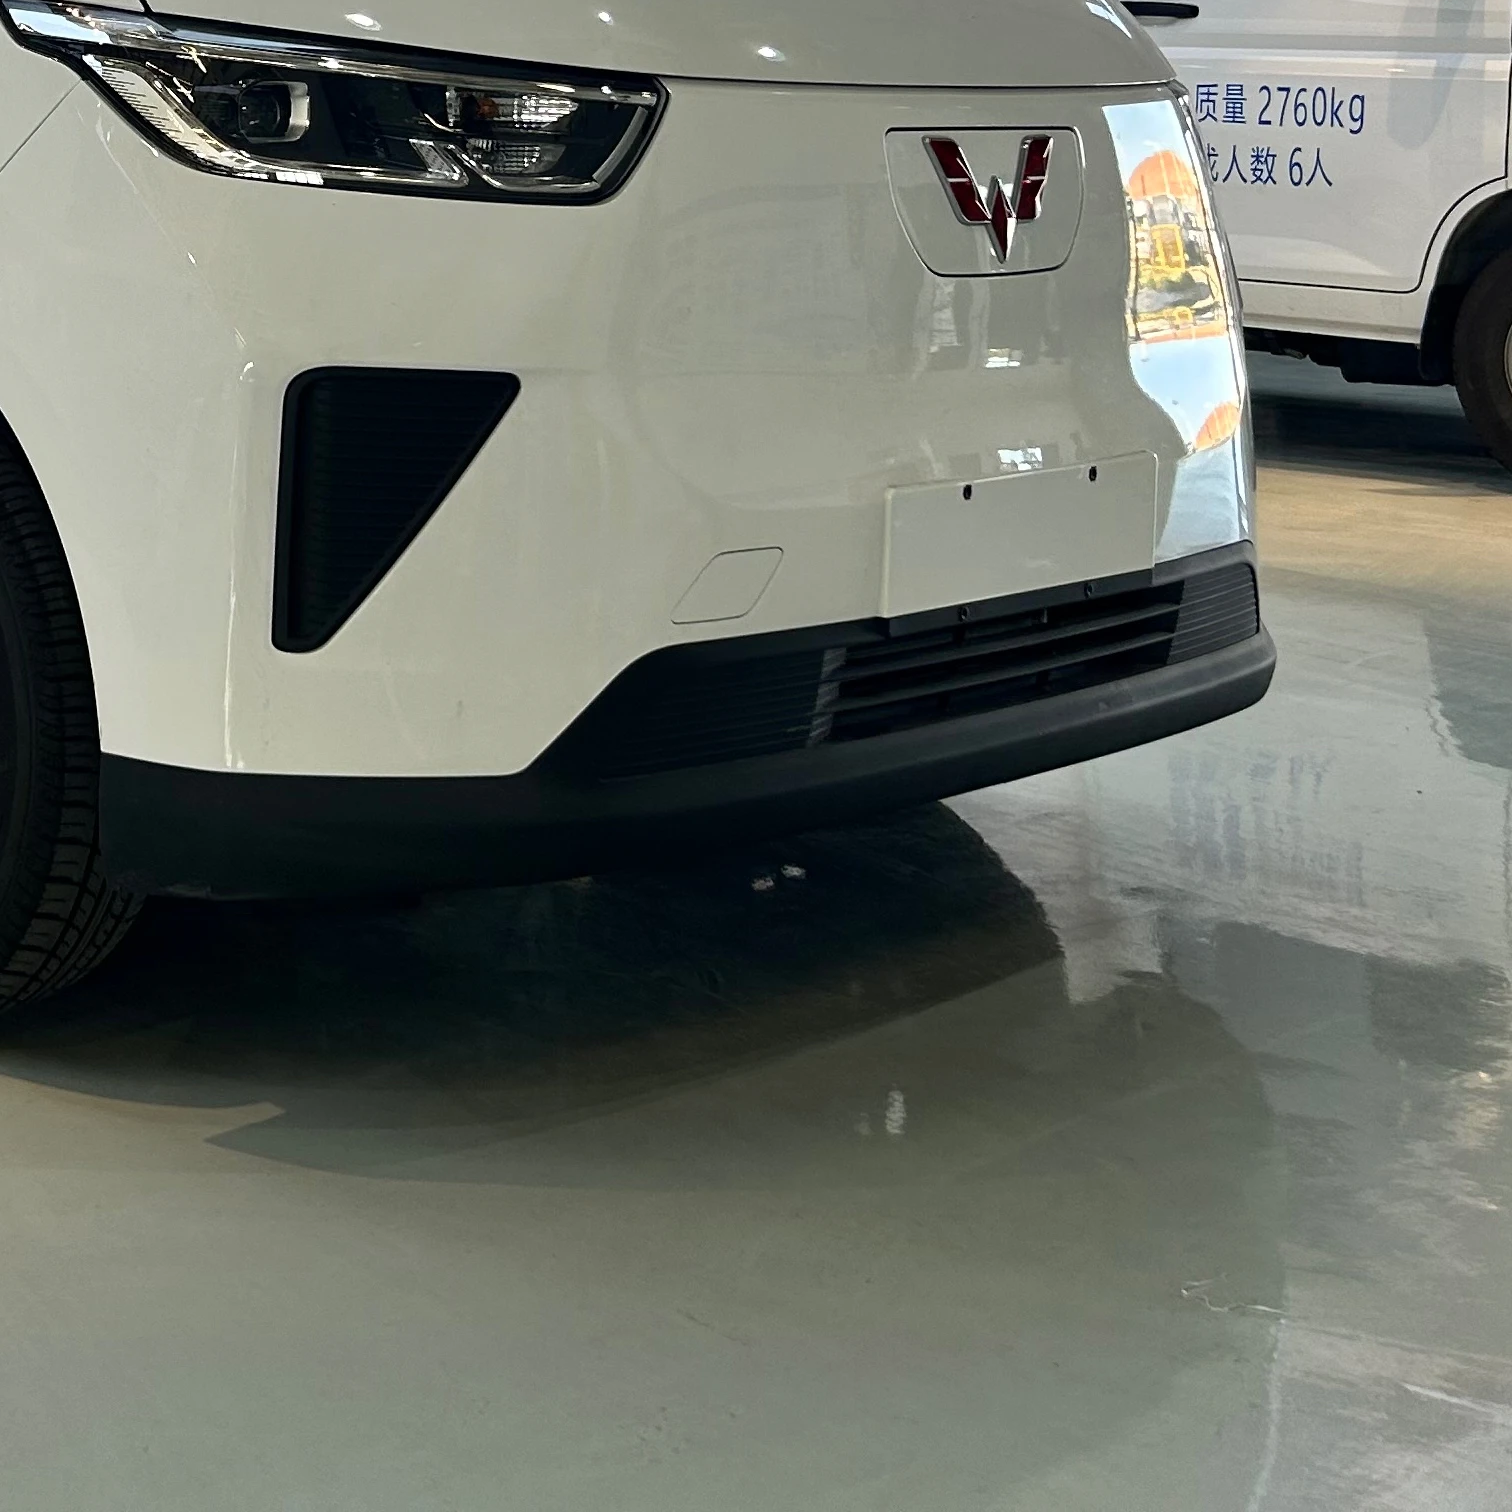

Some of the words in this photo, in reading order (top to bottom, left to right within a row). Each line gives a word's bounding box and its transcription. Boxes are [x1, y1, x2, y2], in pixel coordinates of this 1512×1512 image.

[1195, 83, 1248, 124] 质量
[1257, 84, 1365, 135] 2760kg
[1289, 145, 1333, 187] 6人
